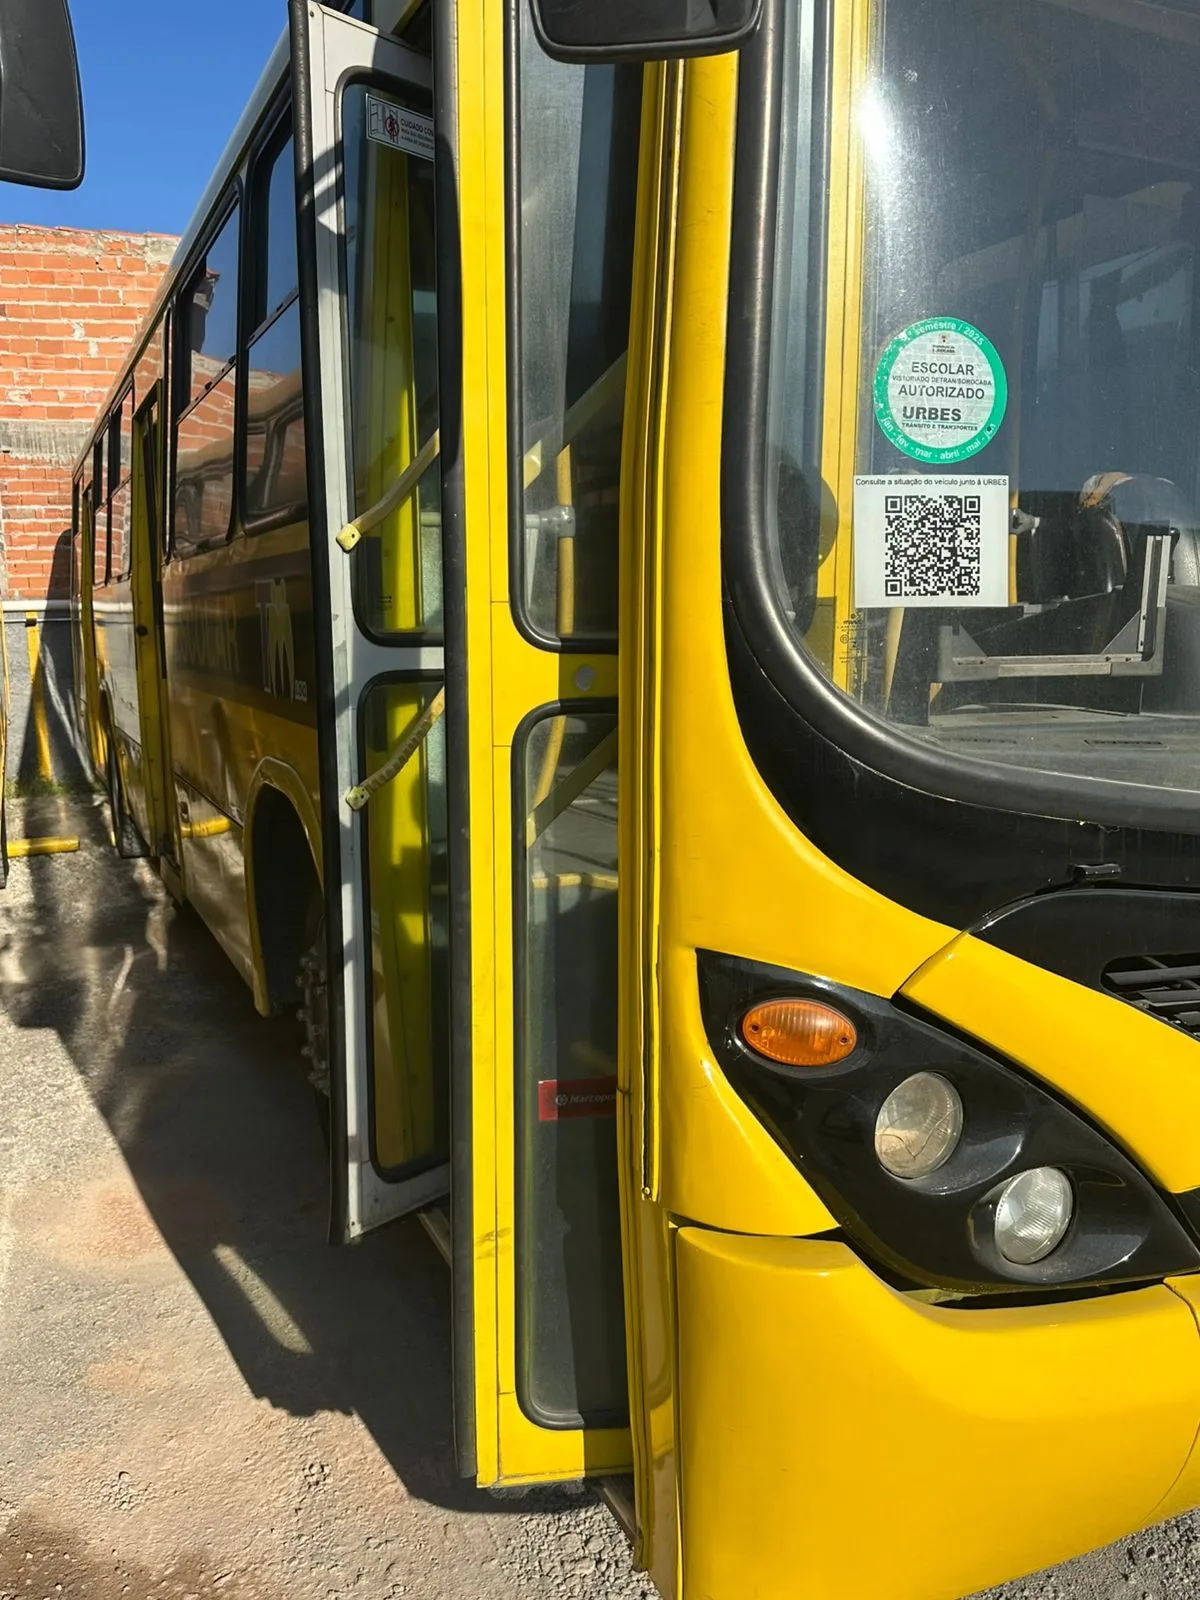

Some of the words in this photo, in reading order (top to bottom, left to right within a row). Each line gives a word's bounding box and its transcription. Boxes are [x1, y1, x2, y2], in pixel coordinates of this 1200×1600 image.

[963, 327, 986, 345] 2025
[911, 361, 975, 376] ESCOLAR
[898, 384, 985, 400] AUTORIZADO
[902, 406, 962, 421] URBES
[895, 434, 910, 448] fev
[914, 447, 932, 458] mar
[940, 449, 960, 459] abril
[966, 439, 981, 453] mai
[894, 477, 923, 487] situação
[958, 478, 976, 487] junto
[982, 478, 1007, 486] URBES
[569, 1092, 617, 1104] Marcopo
